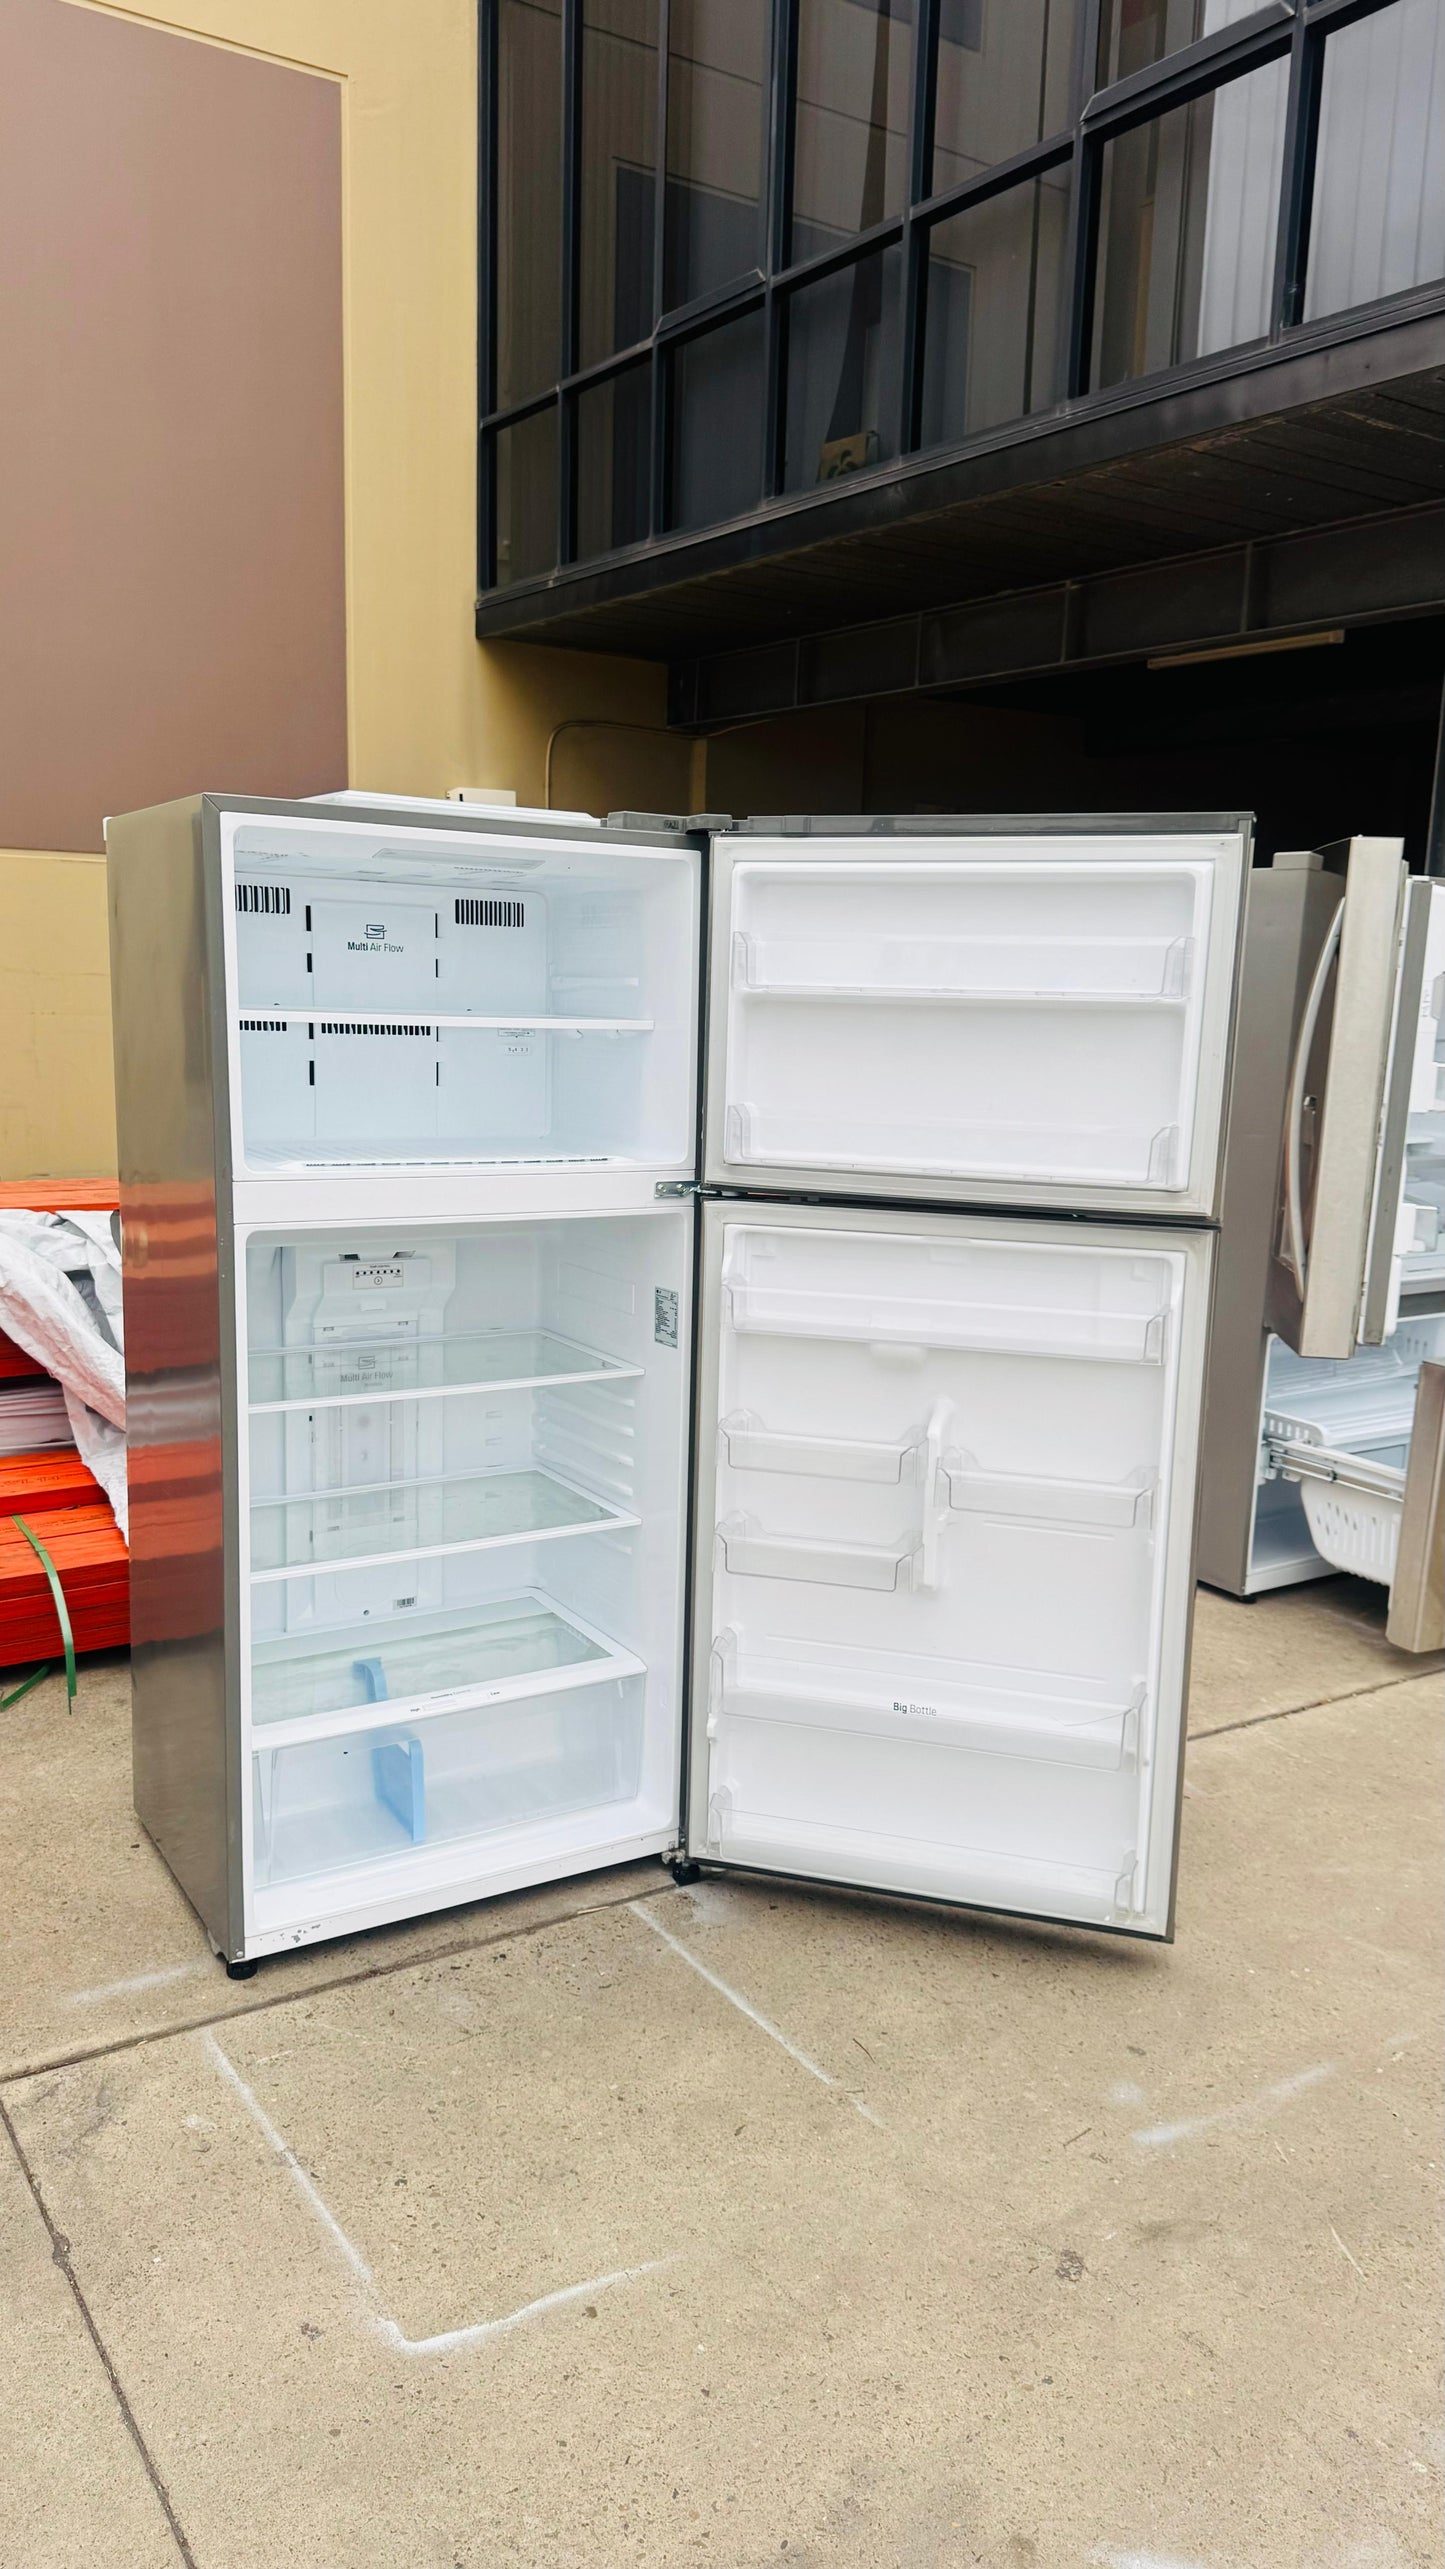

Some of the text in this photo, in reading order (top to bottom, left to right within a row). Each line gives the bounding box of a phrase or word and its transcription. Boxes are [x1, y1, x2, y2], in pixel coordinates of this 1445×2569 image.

[348, 942, 404, 953] Multi Air Flow
[340, 1371, 393, 1382] Multi Air Flow
[893, 1702, 937, 1716] Big Bottle
